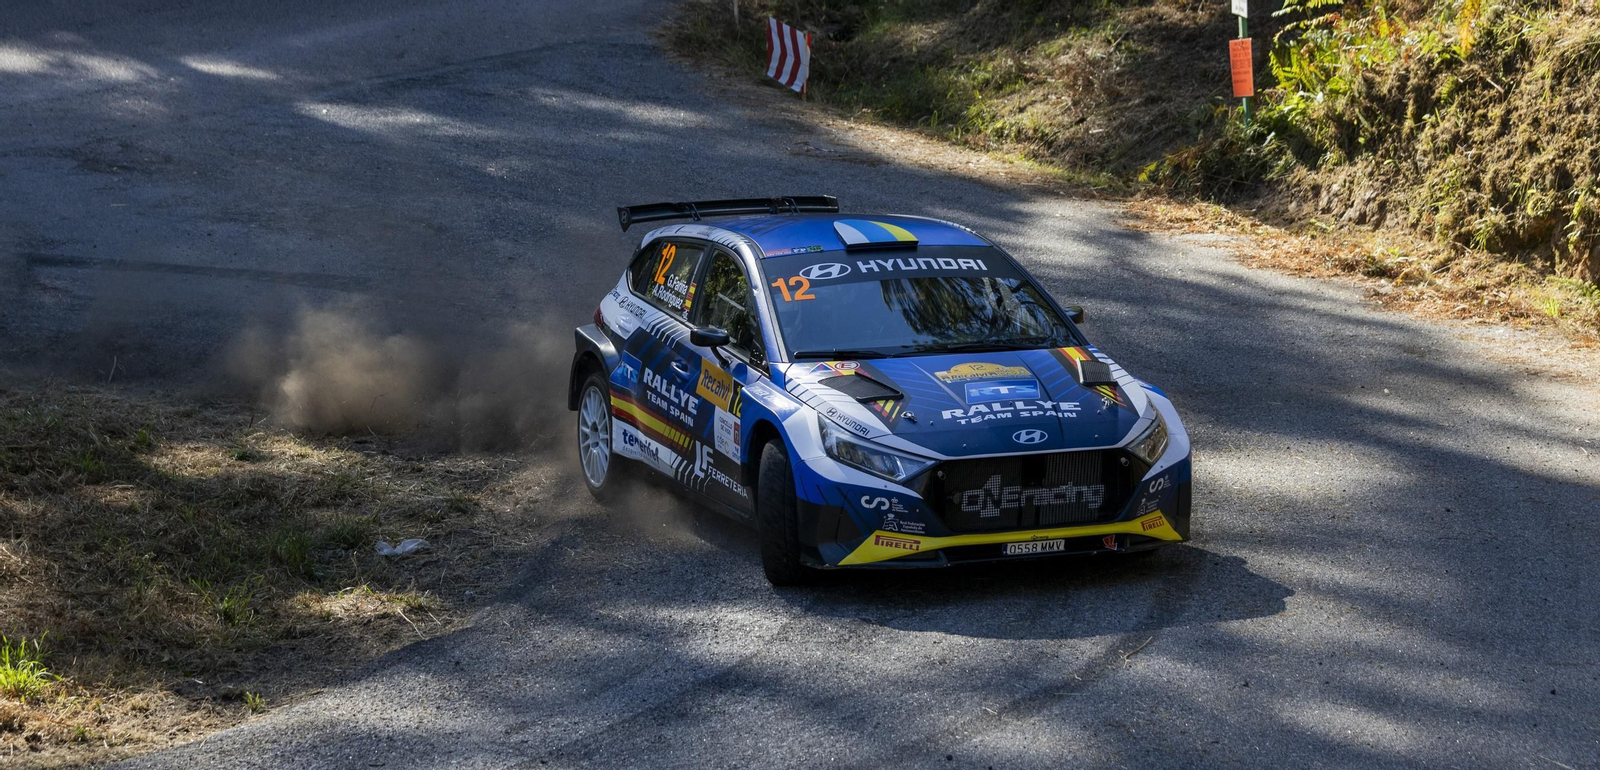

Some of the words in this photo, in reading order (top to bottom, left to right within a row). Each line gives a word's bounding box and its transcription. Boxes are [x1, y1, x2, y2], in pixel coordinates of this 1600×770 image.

[654, 242, 677, 285] 12
[856, 257, 988, 273] HYUNDAI
[771, 276, 816, 302] 12
[624, 300, 648, 319] HYUNDAI
[617, 362, 638, 384] RTS
[643, 367, 699, 415] RALLYE
[701, 368, 730, 401] Recalvi
[969, 385, 1037, 397] RTS
[646, 390, 668, 411] TEAM
[669, 405, 694, 427] SPAIN
[942, 400, 1082, 419] RALLYE
[956, 412, 1012, 424] TEAM
[1019, 410, 1077, 418] SPAIN
[837, 414, 870, 436] HYUNDAI
[707, 465, 748, 499] FERRETERIA
[1140, 515, 1165, 532] PIRELLI
[874, 535, 921, 551] PIRELLI
[1009, 543, 1038, 554] 0558
[1041, 541, 1063, 551] MMV
